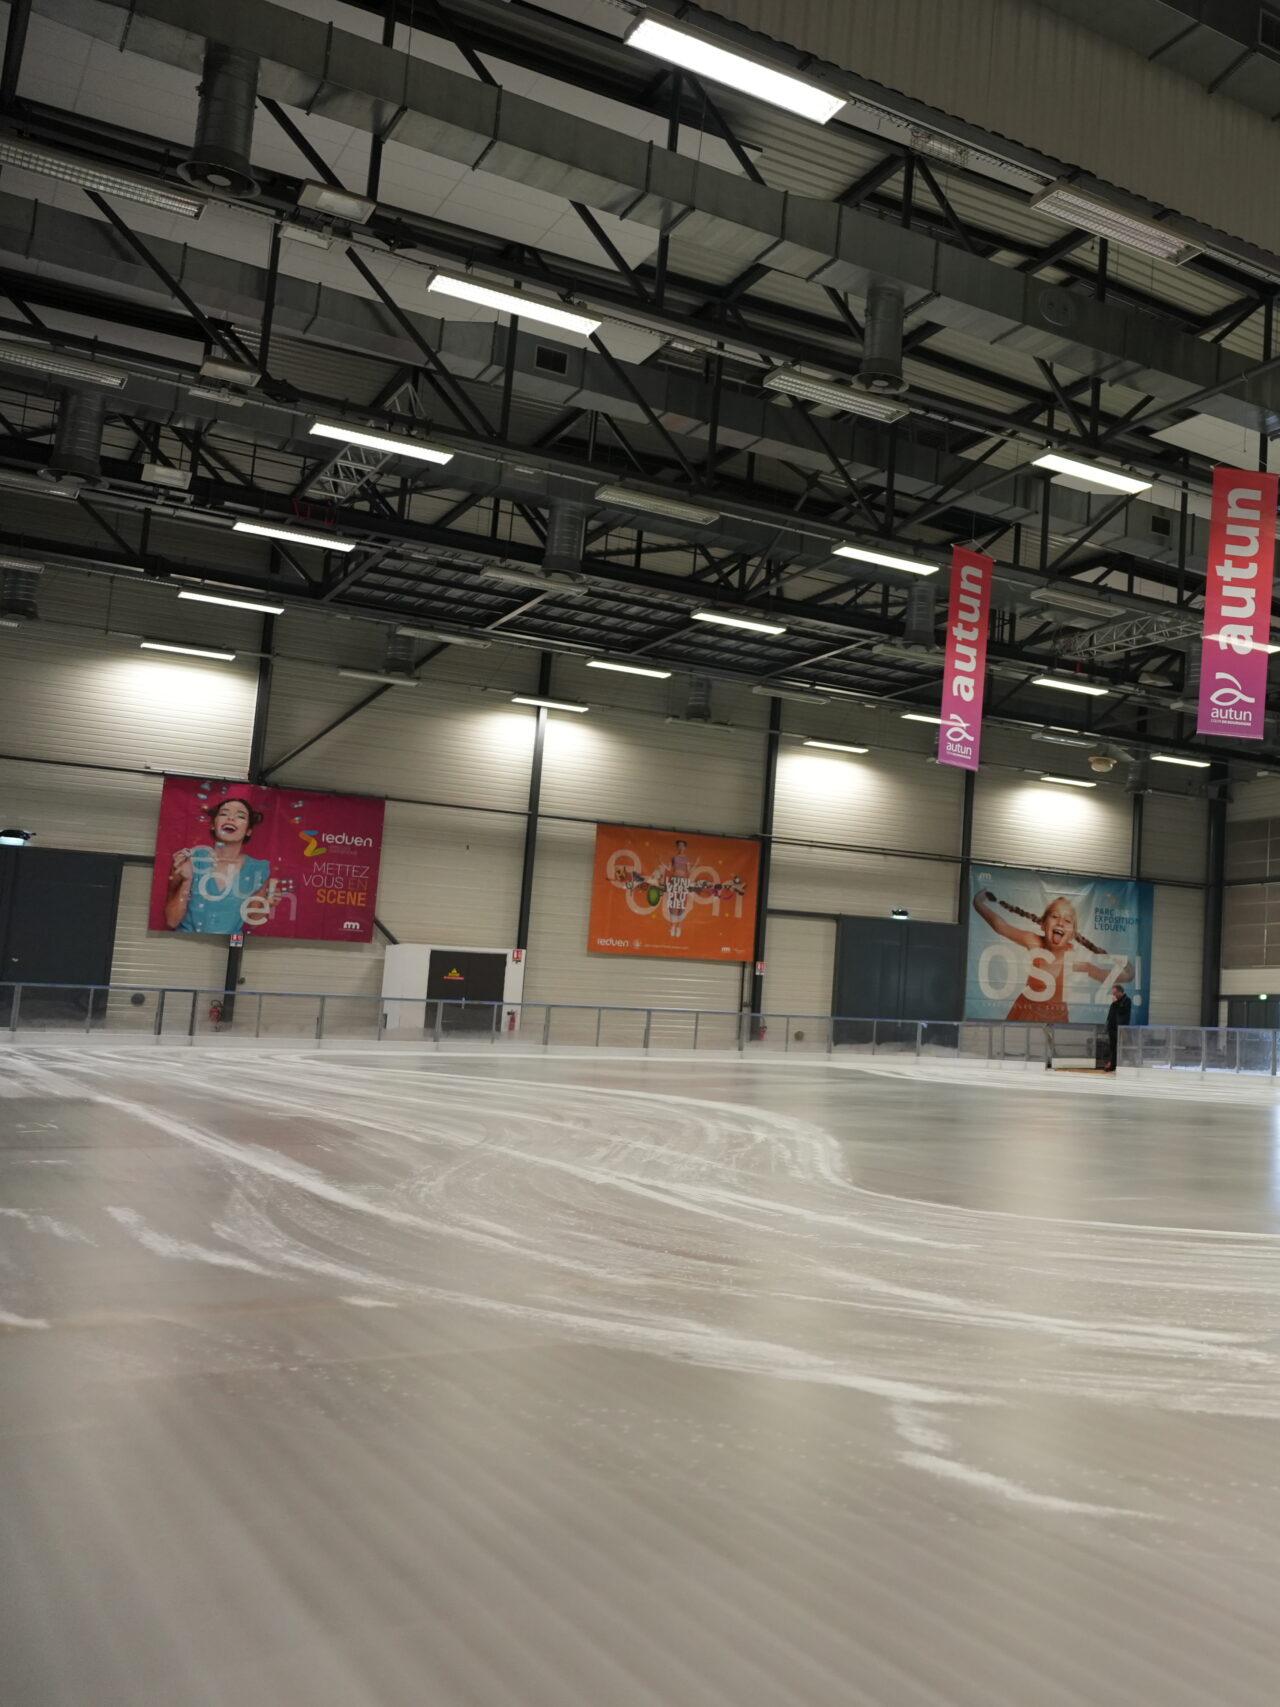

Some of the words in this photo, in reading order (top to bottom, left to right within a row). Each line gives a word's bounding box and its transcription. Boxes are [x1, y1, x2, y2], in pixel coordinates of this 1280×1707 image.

[1215, 487, 1262, 655] autun
[952, 563, 983, 702] autun
[1211, 707, 1252, 721] autun
[946, 742, 972, 755] autun
[313, 862, 370, 878] METTEZ
[303, 873, 344, 889] VOUS
[316, 888, 367, 907] SCENE
[1095, 907, 1115, 916] PARC
